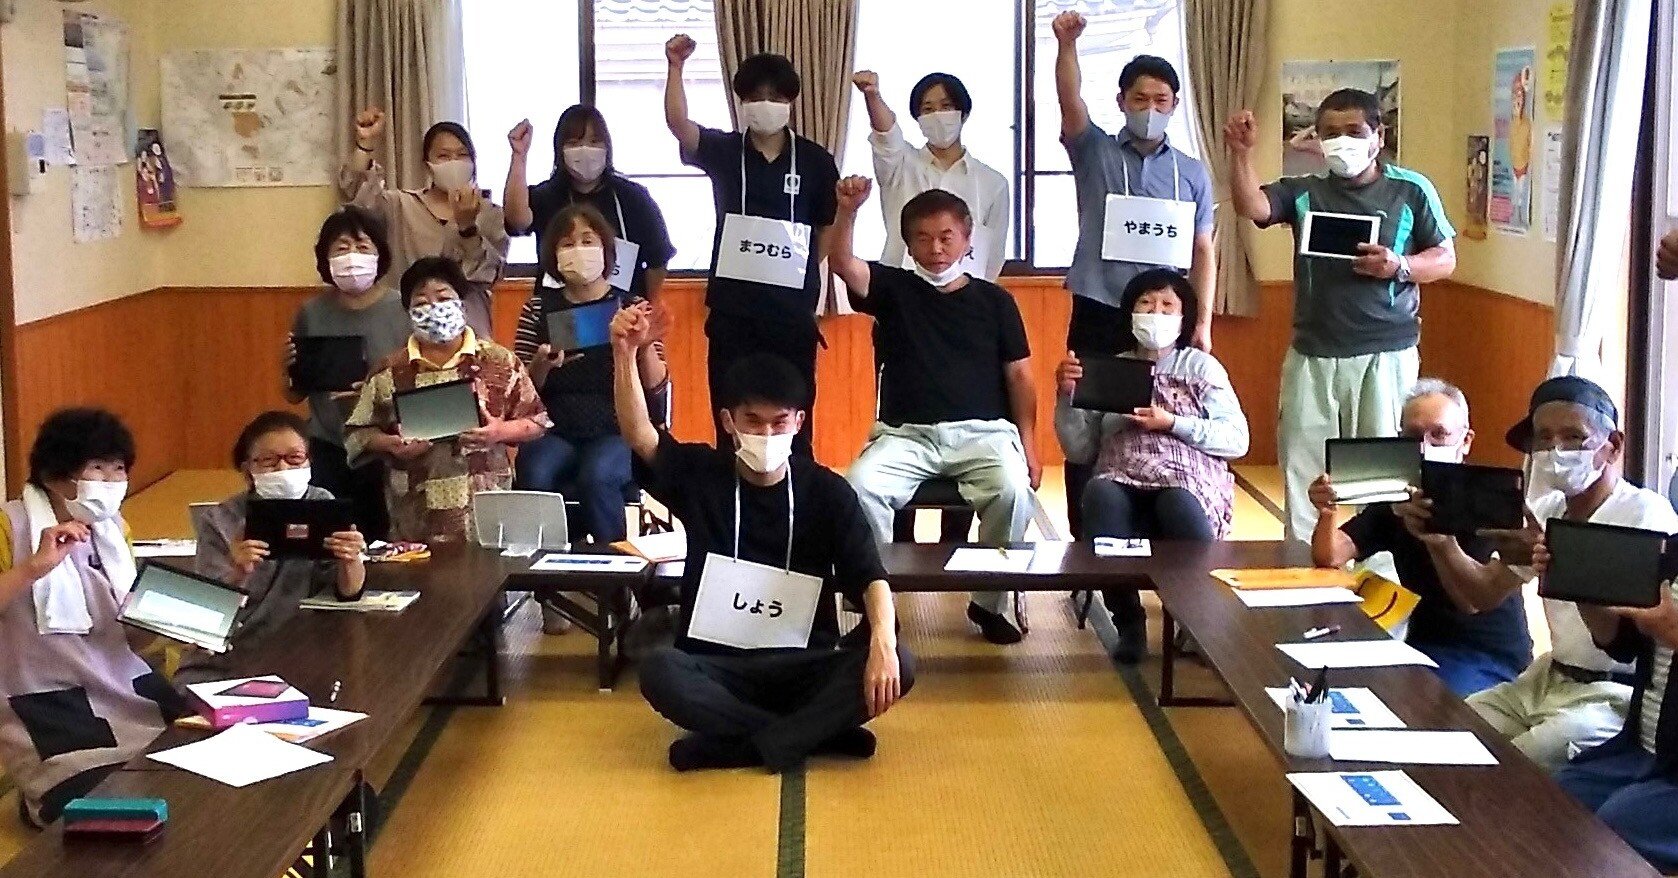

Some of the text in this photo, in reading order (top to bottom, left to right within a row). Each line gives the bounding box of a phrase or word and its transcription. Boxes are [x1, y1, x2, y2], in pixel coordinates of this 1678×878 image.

[1124, 220, 1178, 238] やまうち
[739, 239, 792, 259] まつむら
[733, 592, 783, 618] しょう
